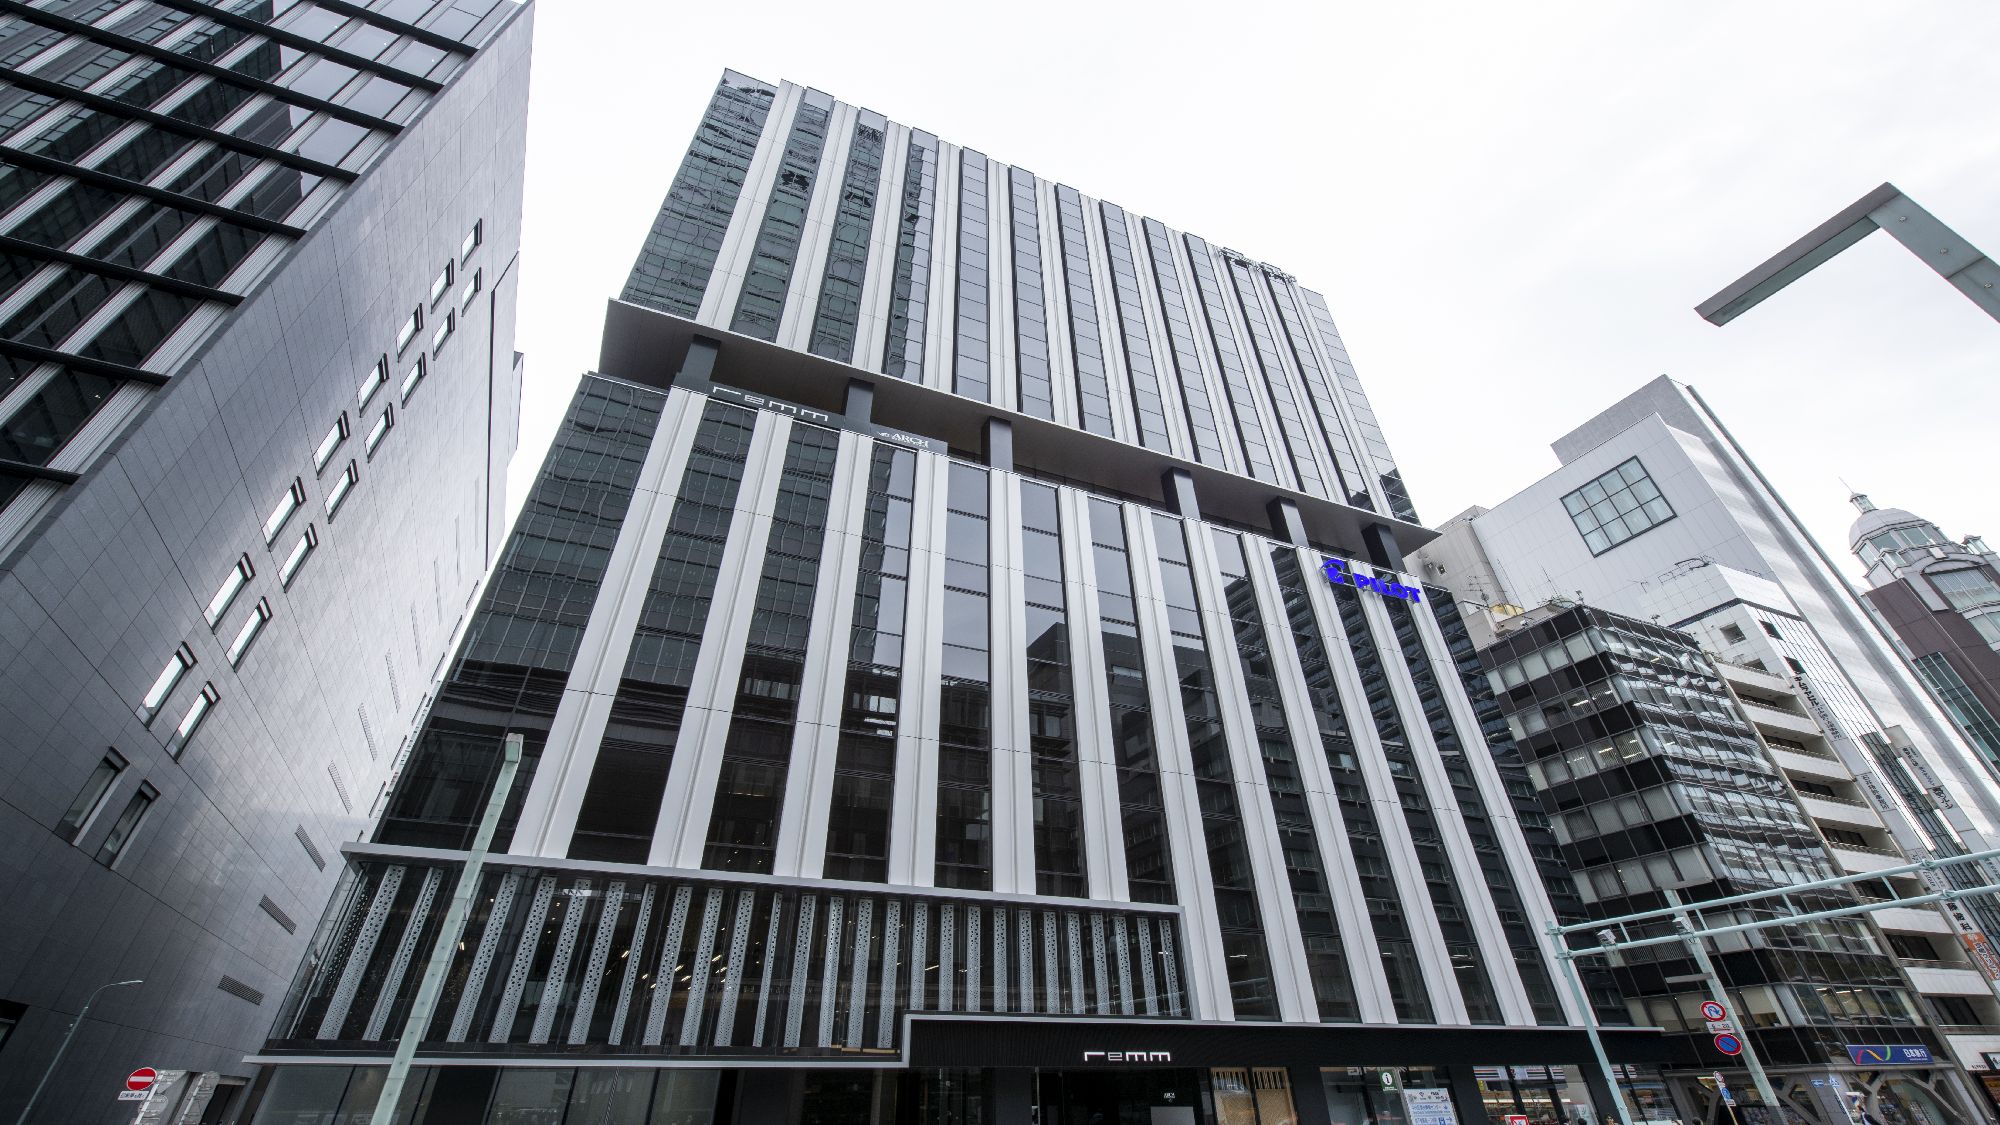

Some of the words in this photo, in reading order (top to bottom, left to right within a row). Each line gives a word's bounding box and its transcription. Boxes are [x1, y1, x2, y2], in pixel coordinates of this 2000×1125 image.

[712, 385, 828, 422] remm
[1353, 573, 1420, 603] PILOT
[1084, 1051, 1171, 1062] remm
